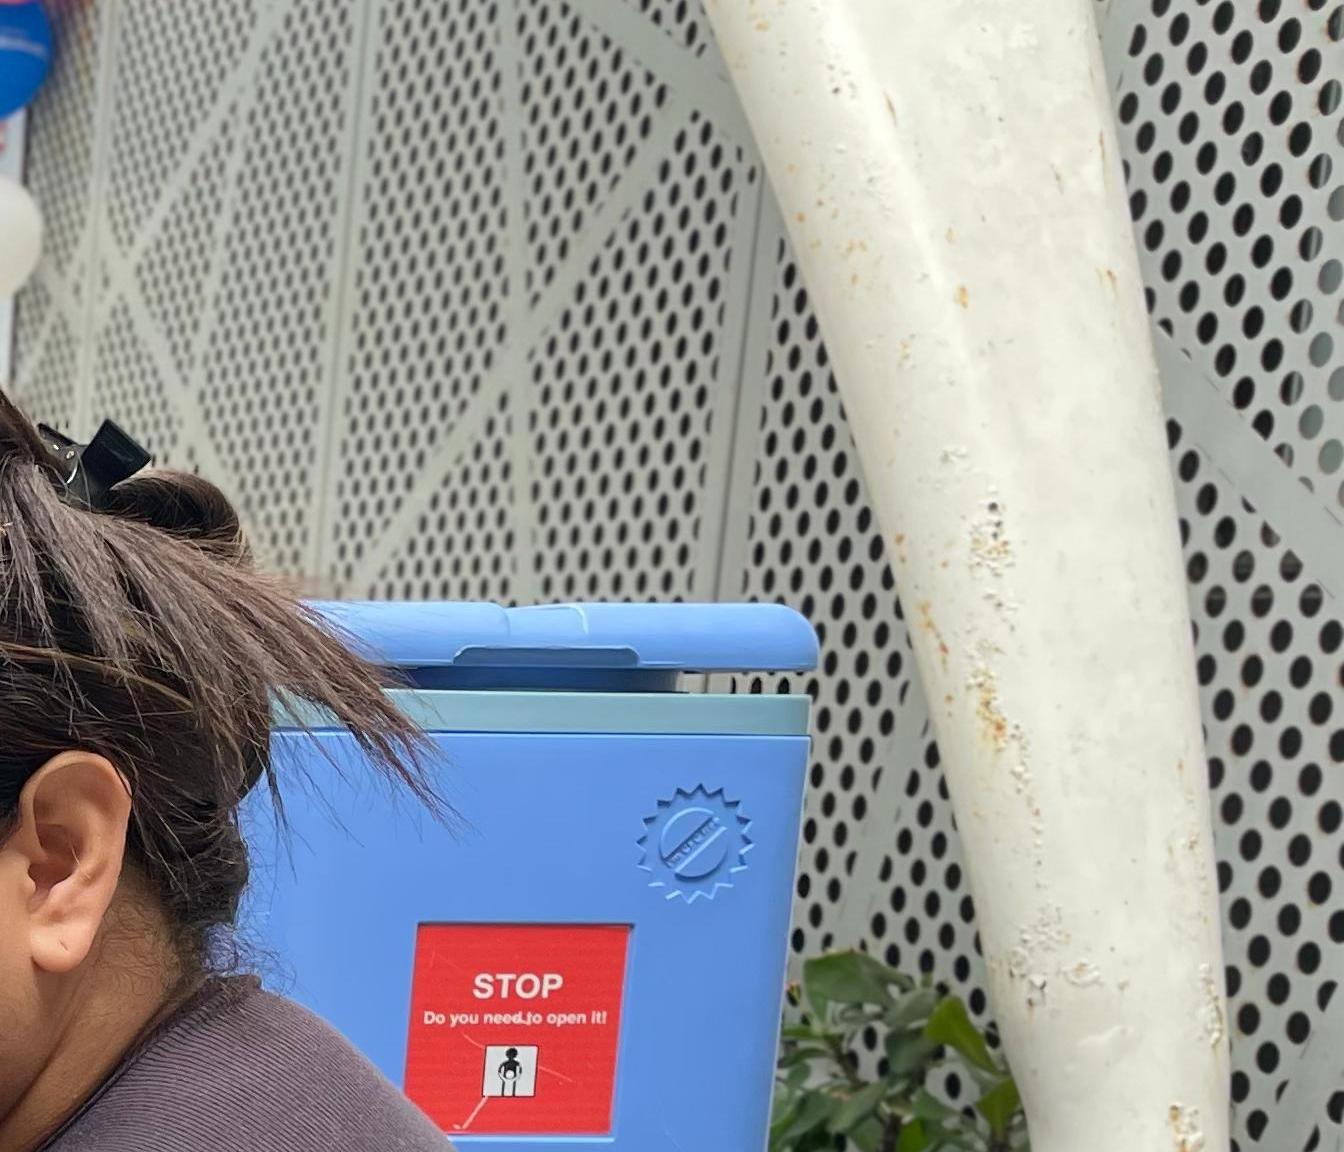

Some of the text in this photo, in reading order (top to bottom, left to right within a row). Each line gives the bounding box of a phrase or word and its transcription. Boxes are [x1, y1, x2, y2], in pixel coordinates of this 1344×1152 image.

[472, 973, 563, 999] STOP
[423, 1011, 445, 1025] Do
[450, 1013, 479, 1028] you
[483, 1011, 523, 1025] need
[525, 1011, 543, 1025] to
[546, 1013, 586, 1028] open
